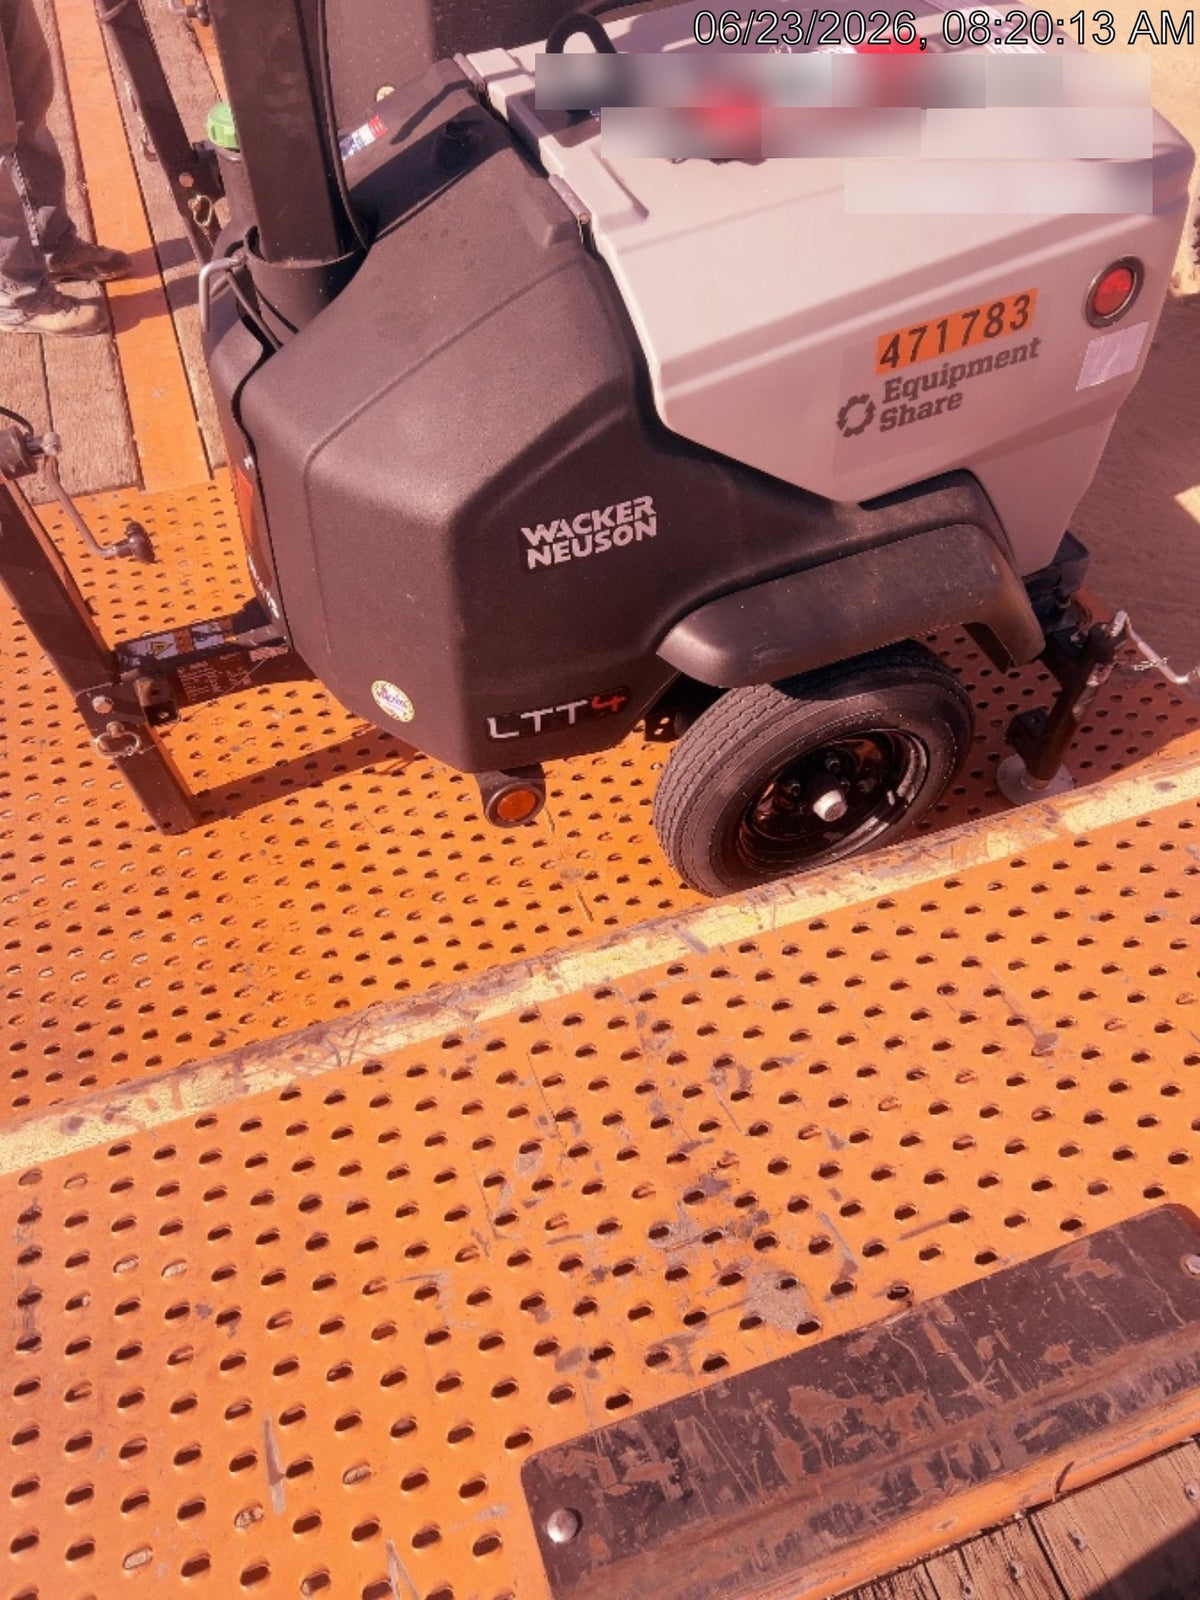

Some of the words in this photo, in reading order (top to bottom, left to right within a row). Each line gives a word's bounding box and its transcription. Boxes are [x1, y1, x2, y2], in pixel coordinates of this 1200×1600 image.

[879, 294, 1031, 369] 471783
[881, 336, 1042, 404] Equipment
[879, 392, 963, 433] Share
[520, 495, 657, 547] WACKER
[526, 516, 657, 570] NEUSON
[486, 695, 627, 739] LTT4
